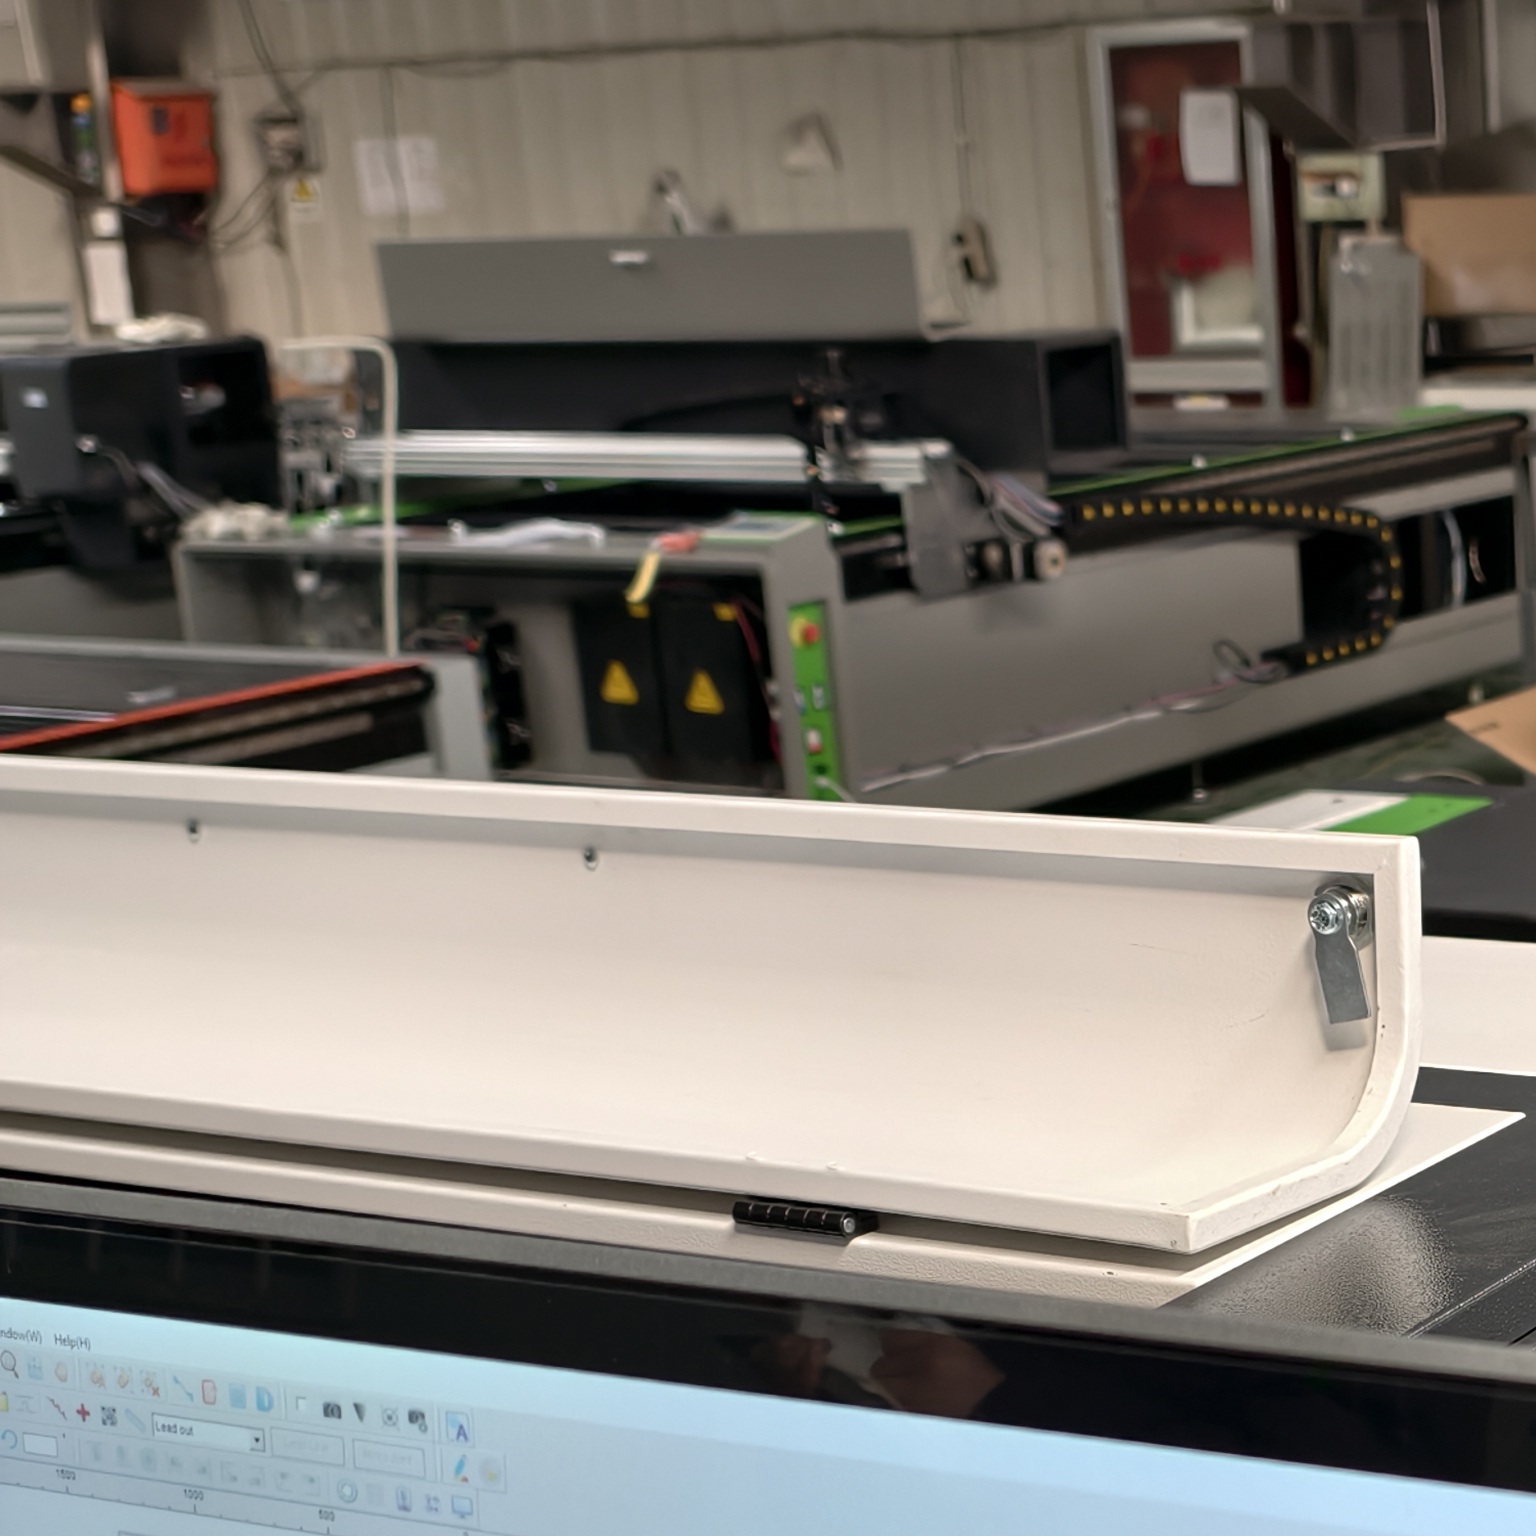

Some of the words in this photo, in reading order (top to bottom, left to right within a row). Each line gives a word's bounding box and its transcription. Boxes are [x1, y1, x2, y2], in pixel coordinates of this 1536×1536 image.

[0, 1327, 43, 1345] ndow(W)
[54, 1333, 91, 1350] Help(H)
[155, 1420, 178, 1435] Lead
[179, 1425, 194, 1437] out
[183, 1488, 205, 1501] 1000
